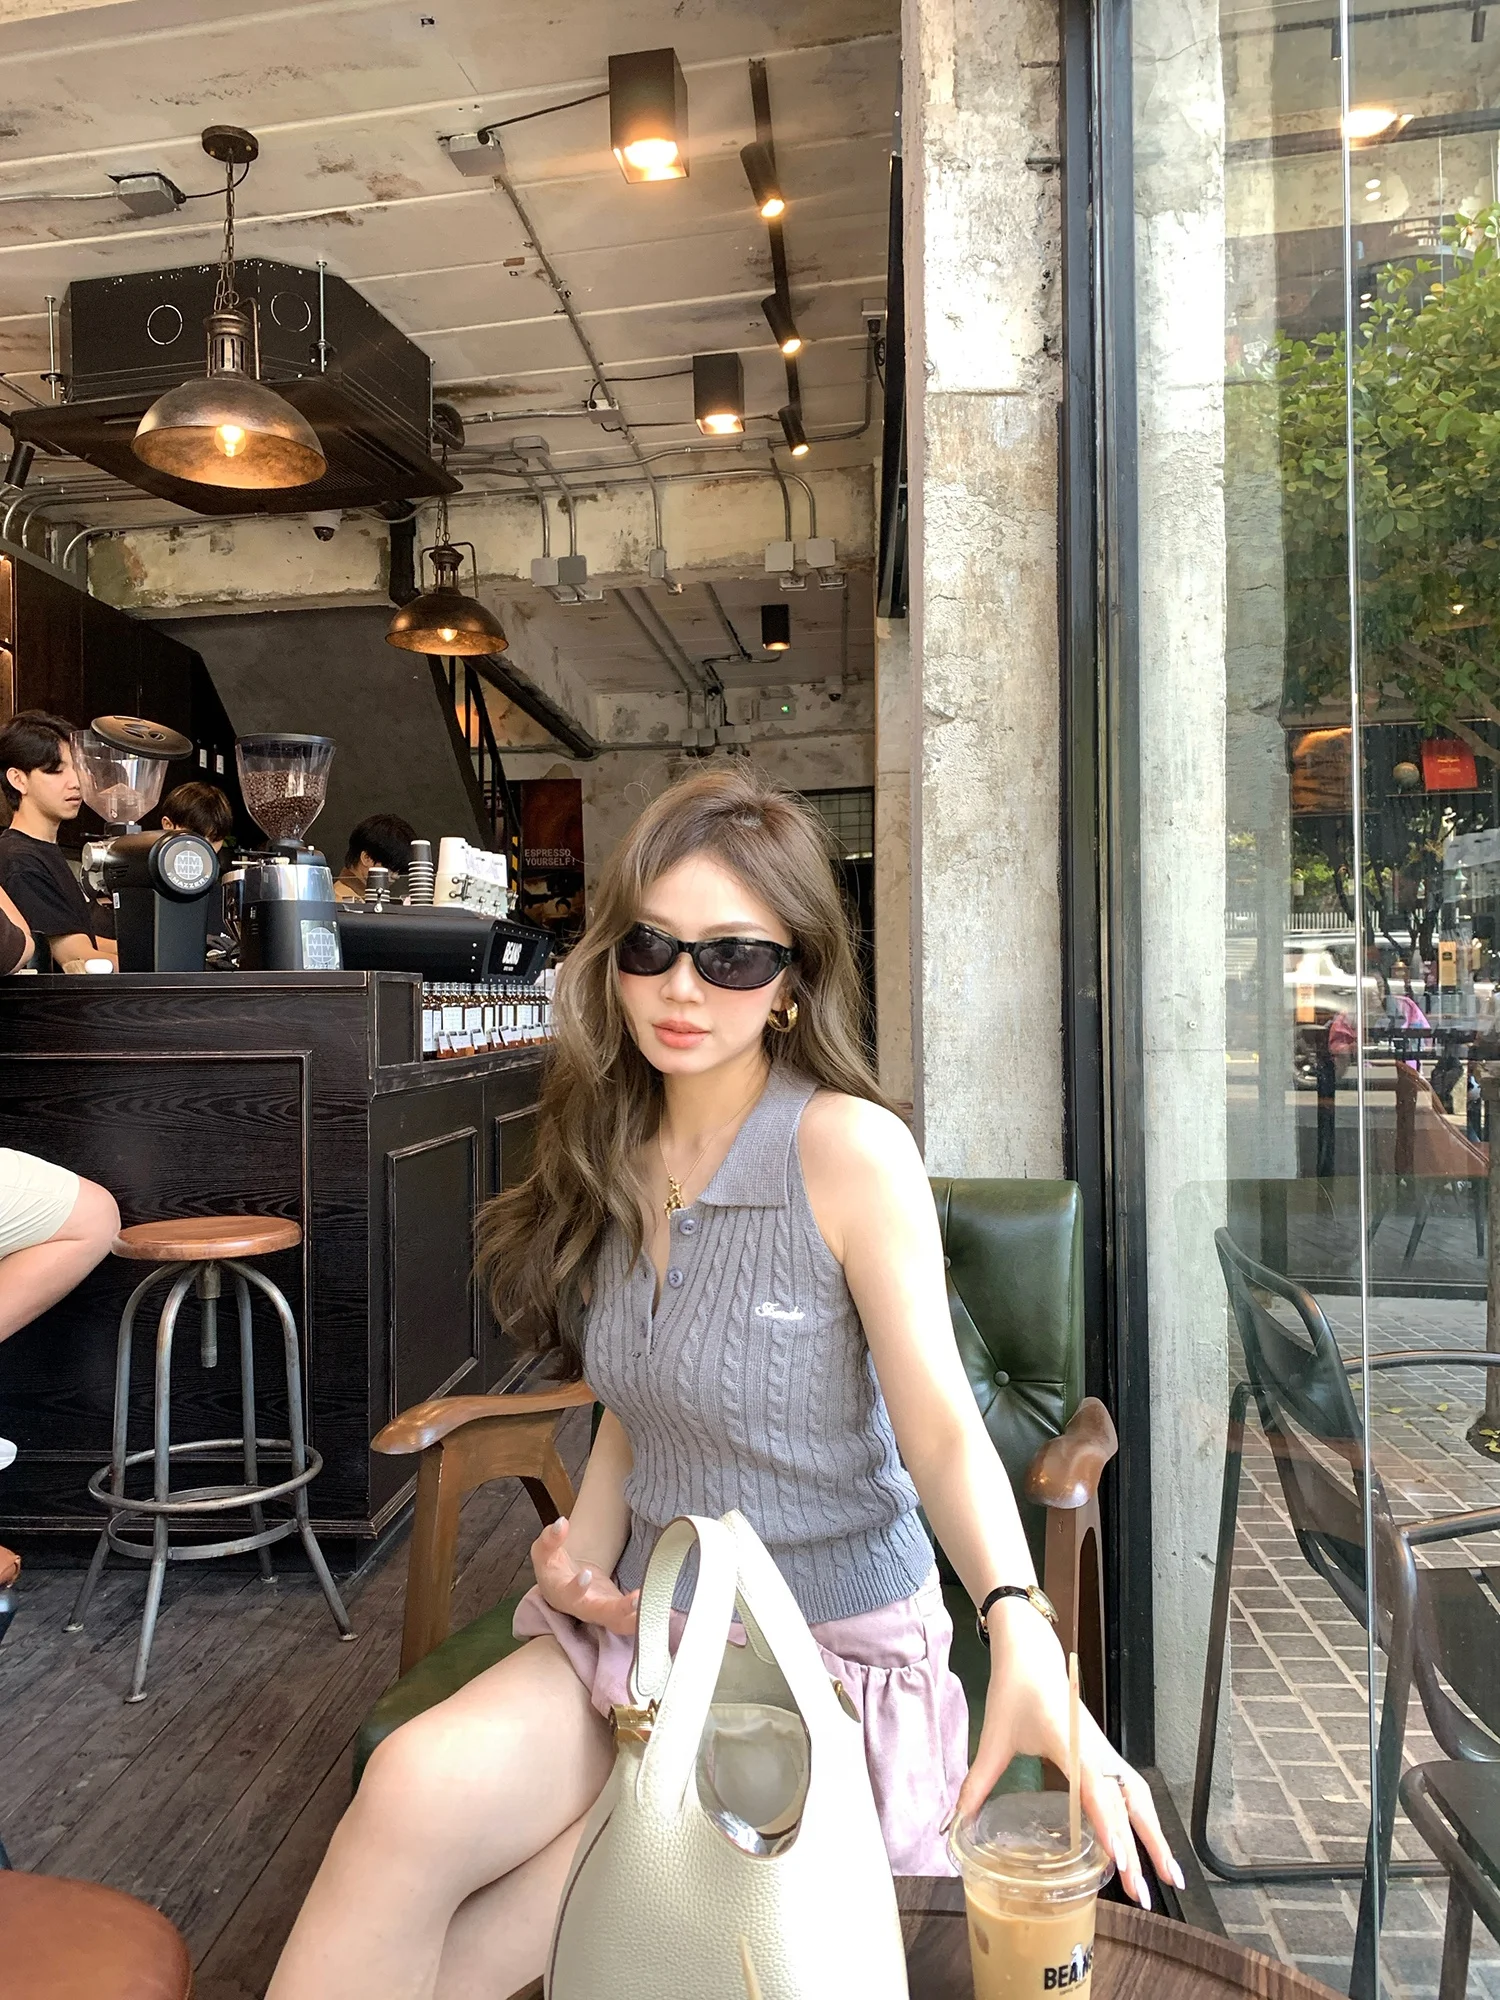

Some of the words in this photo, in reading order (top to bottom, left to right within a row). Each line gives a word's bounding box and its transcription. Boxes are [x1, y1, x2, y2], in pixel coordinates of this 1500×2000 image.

[524, 848, 571, 858] ESPRESSO
[525, 857, 576, 866] YOURSELF!
[172, 876, 206, 888] MAZZER
